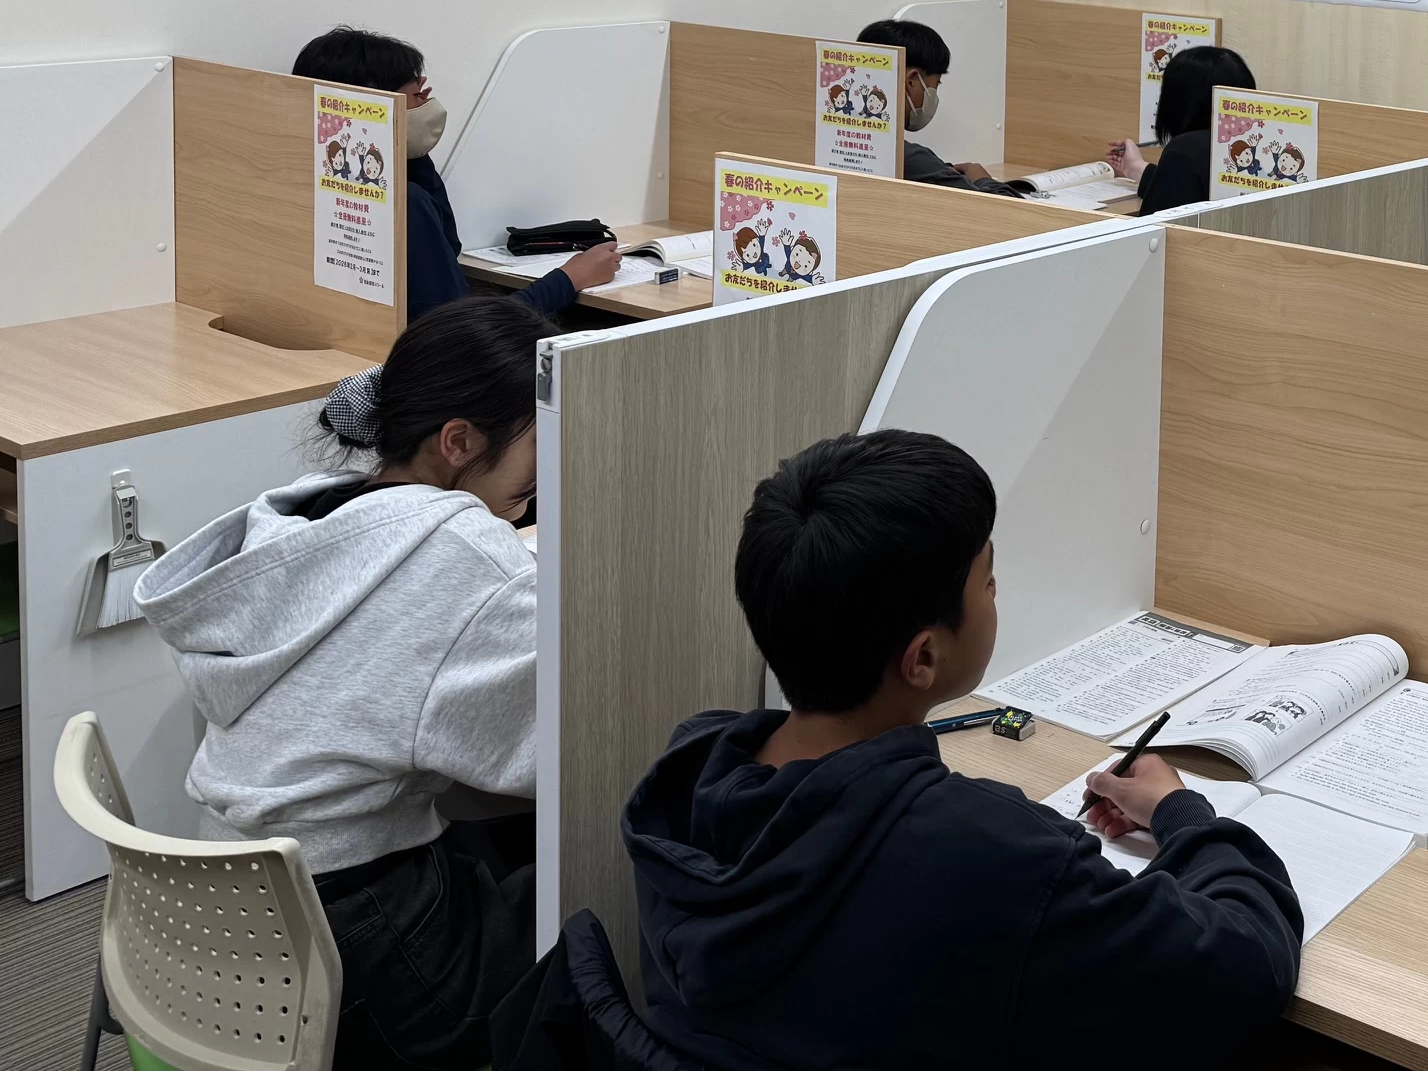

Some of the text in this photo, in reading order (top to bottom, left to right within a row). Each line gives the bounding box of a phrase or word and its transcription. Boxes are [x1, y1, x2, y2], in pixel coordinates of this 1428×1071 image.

[1148, 21, 1207, 33] 春の紹介キャンペーン
[823, 50, 889, 67] 春の紹介キャンペーン
[320, 97, 385, 119] 春の紹介キャンペーン
[1222, 100, 1308, 121] 春の紹介キャンペーン
[725, 174, 823, 201] 春の紹介キャンペーン
